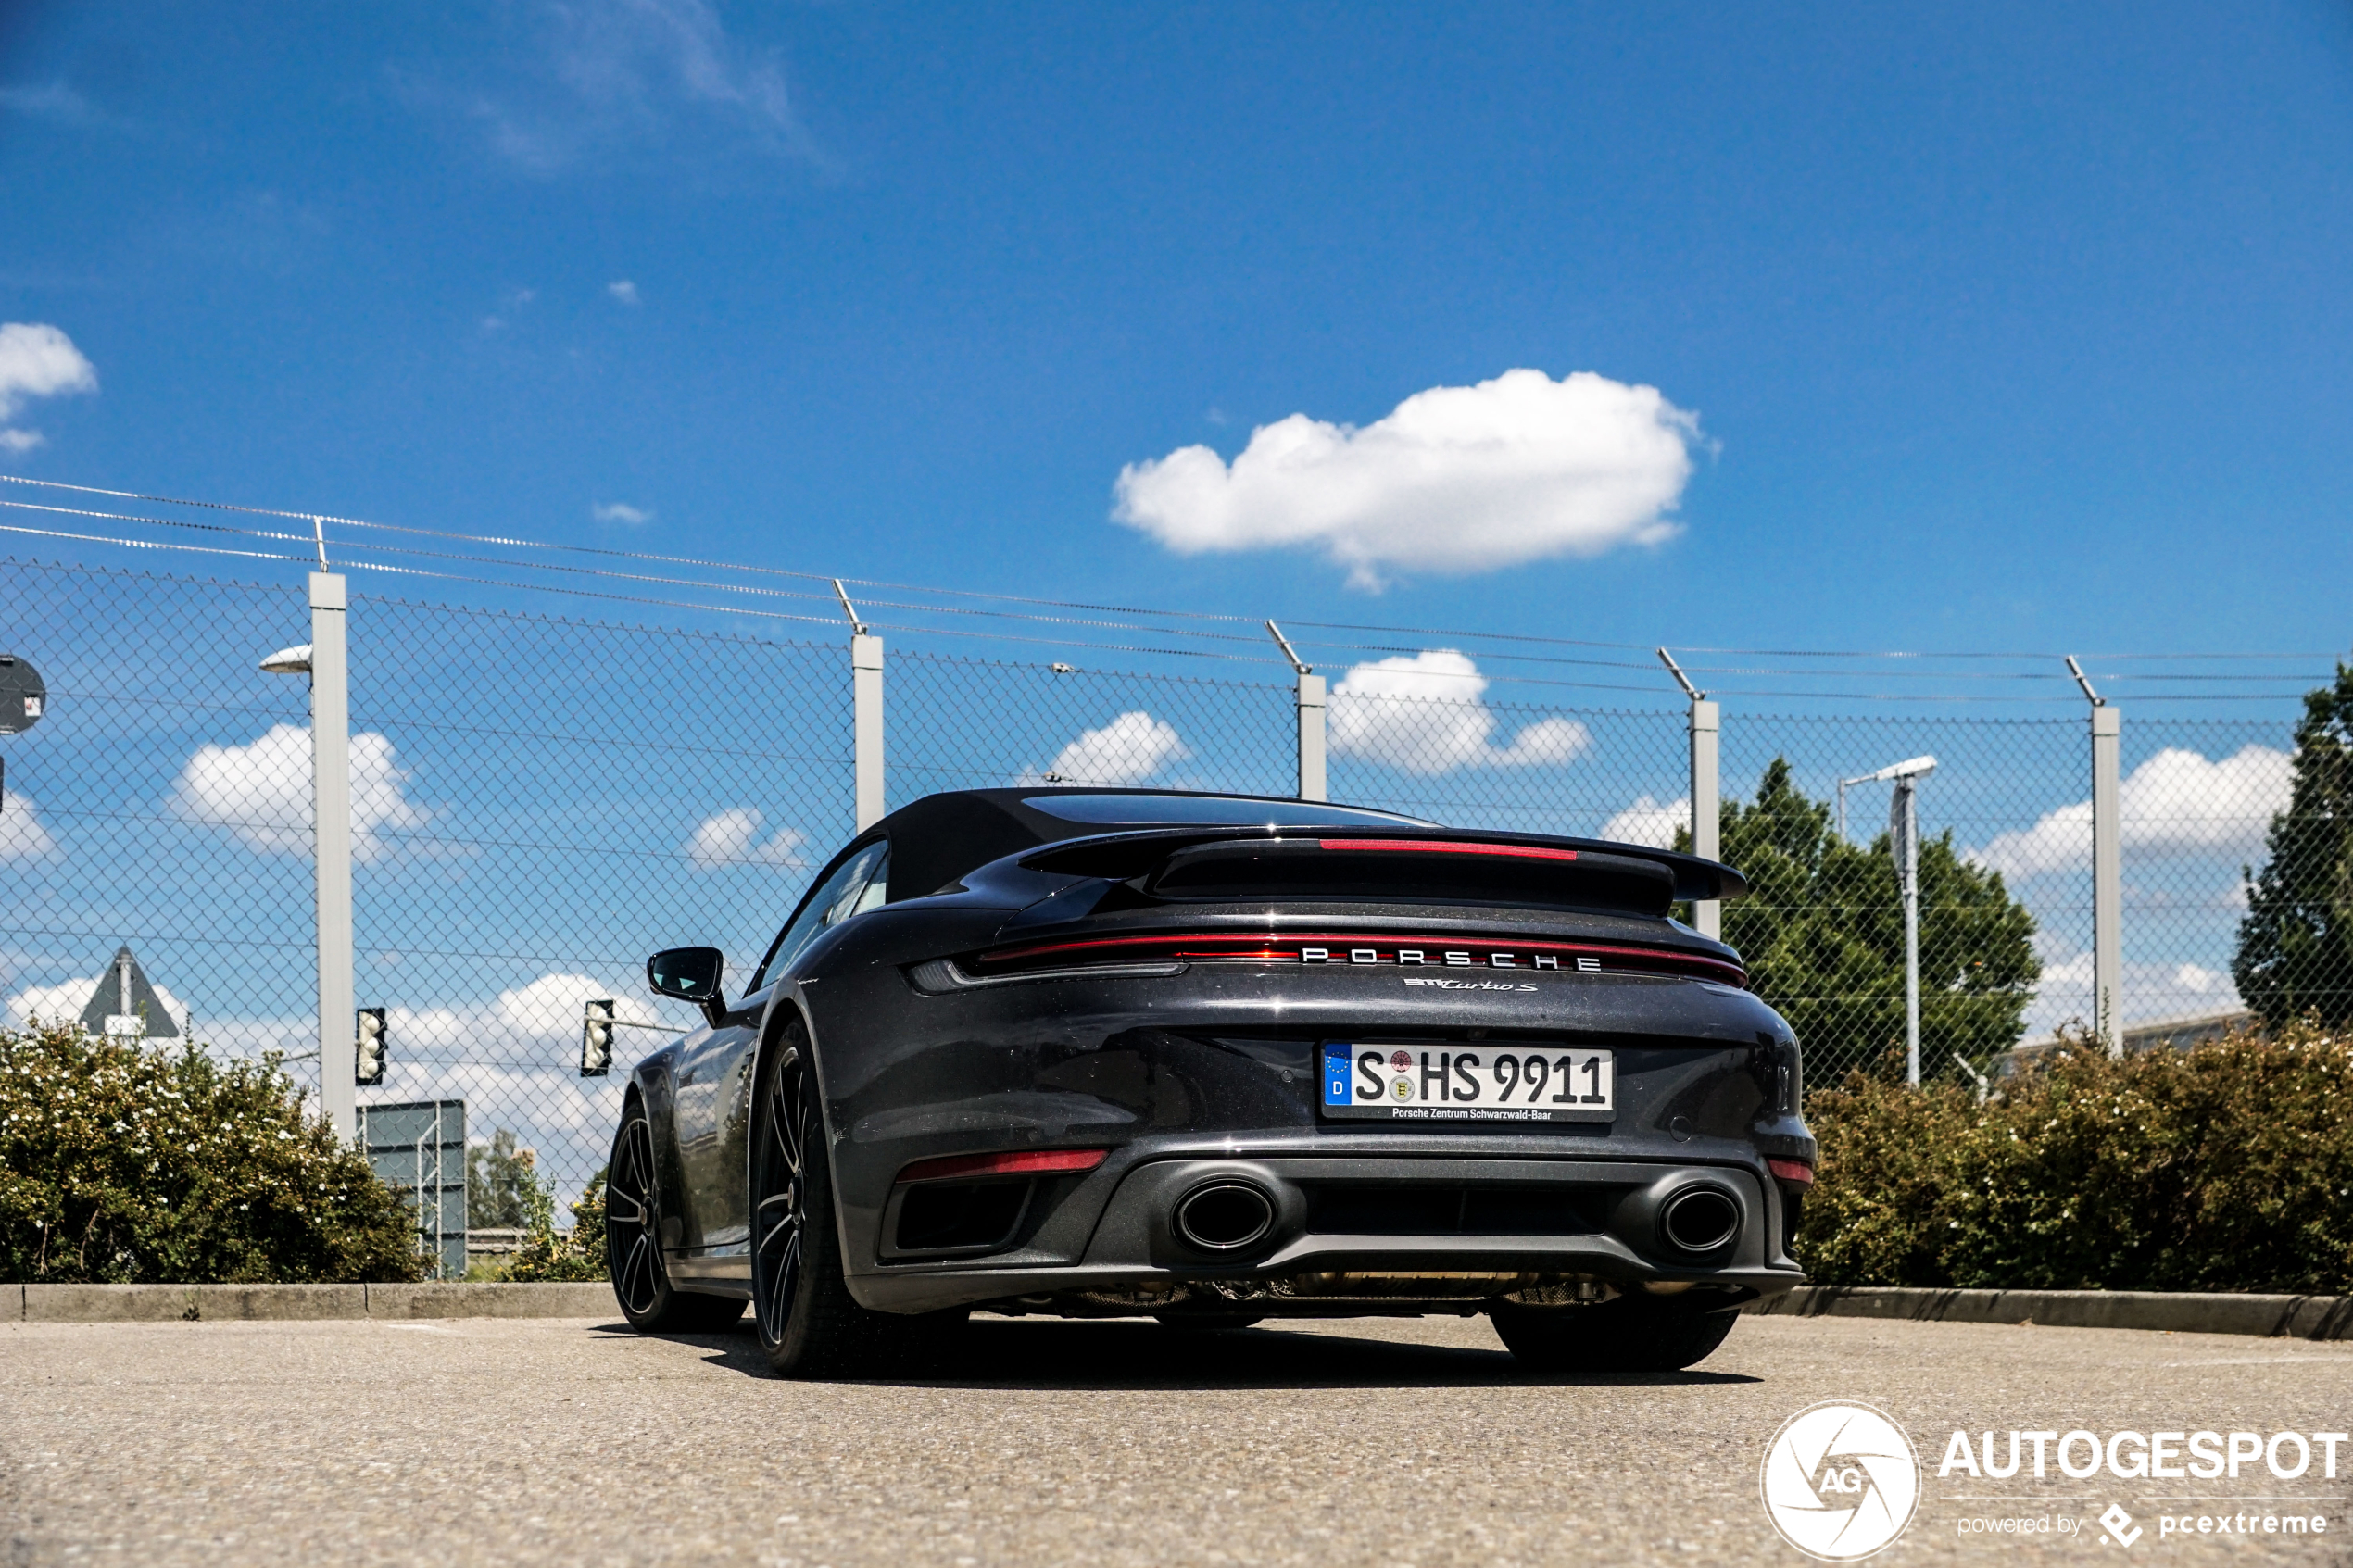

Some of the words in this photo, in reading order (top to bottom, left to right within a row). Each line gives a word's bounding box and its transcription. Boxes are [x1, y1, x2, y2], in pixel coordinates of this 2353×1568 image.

[1302, 947, 1602, 972] PORSCHE
[1515, 983, 1539, 992] S
[1355, 1051, 1385, 1100] S
[1420, 1052, 1481, 1102] HS
[1493, 1053, 1606, 1104] 9911
[1333, 1082, 1343, 1095] D
[1392, 1108, 1429, 1119] Porsche
[1430, 1108, 1468, 1119] Zentrum
[1470, 1109, 1552, 1120] Schwarzwald-Baar
